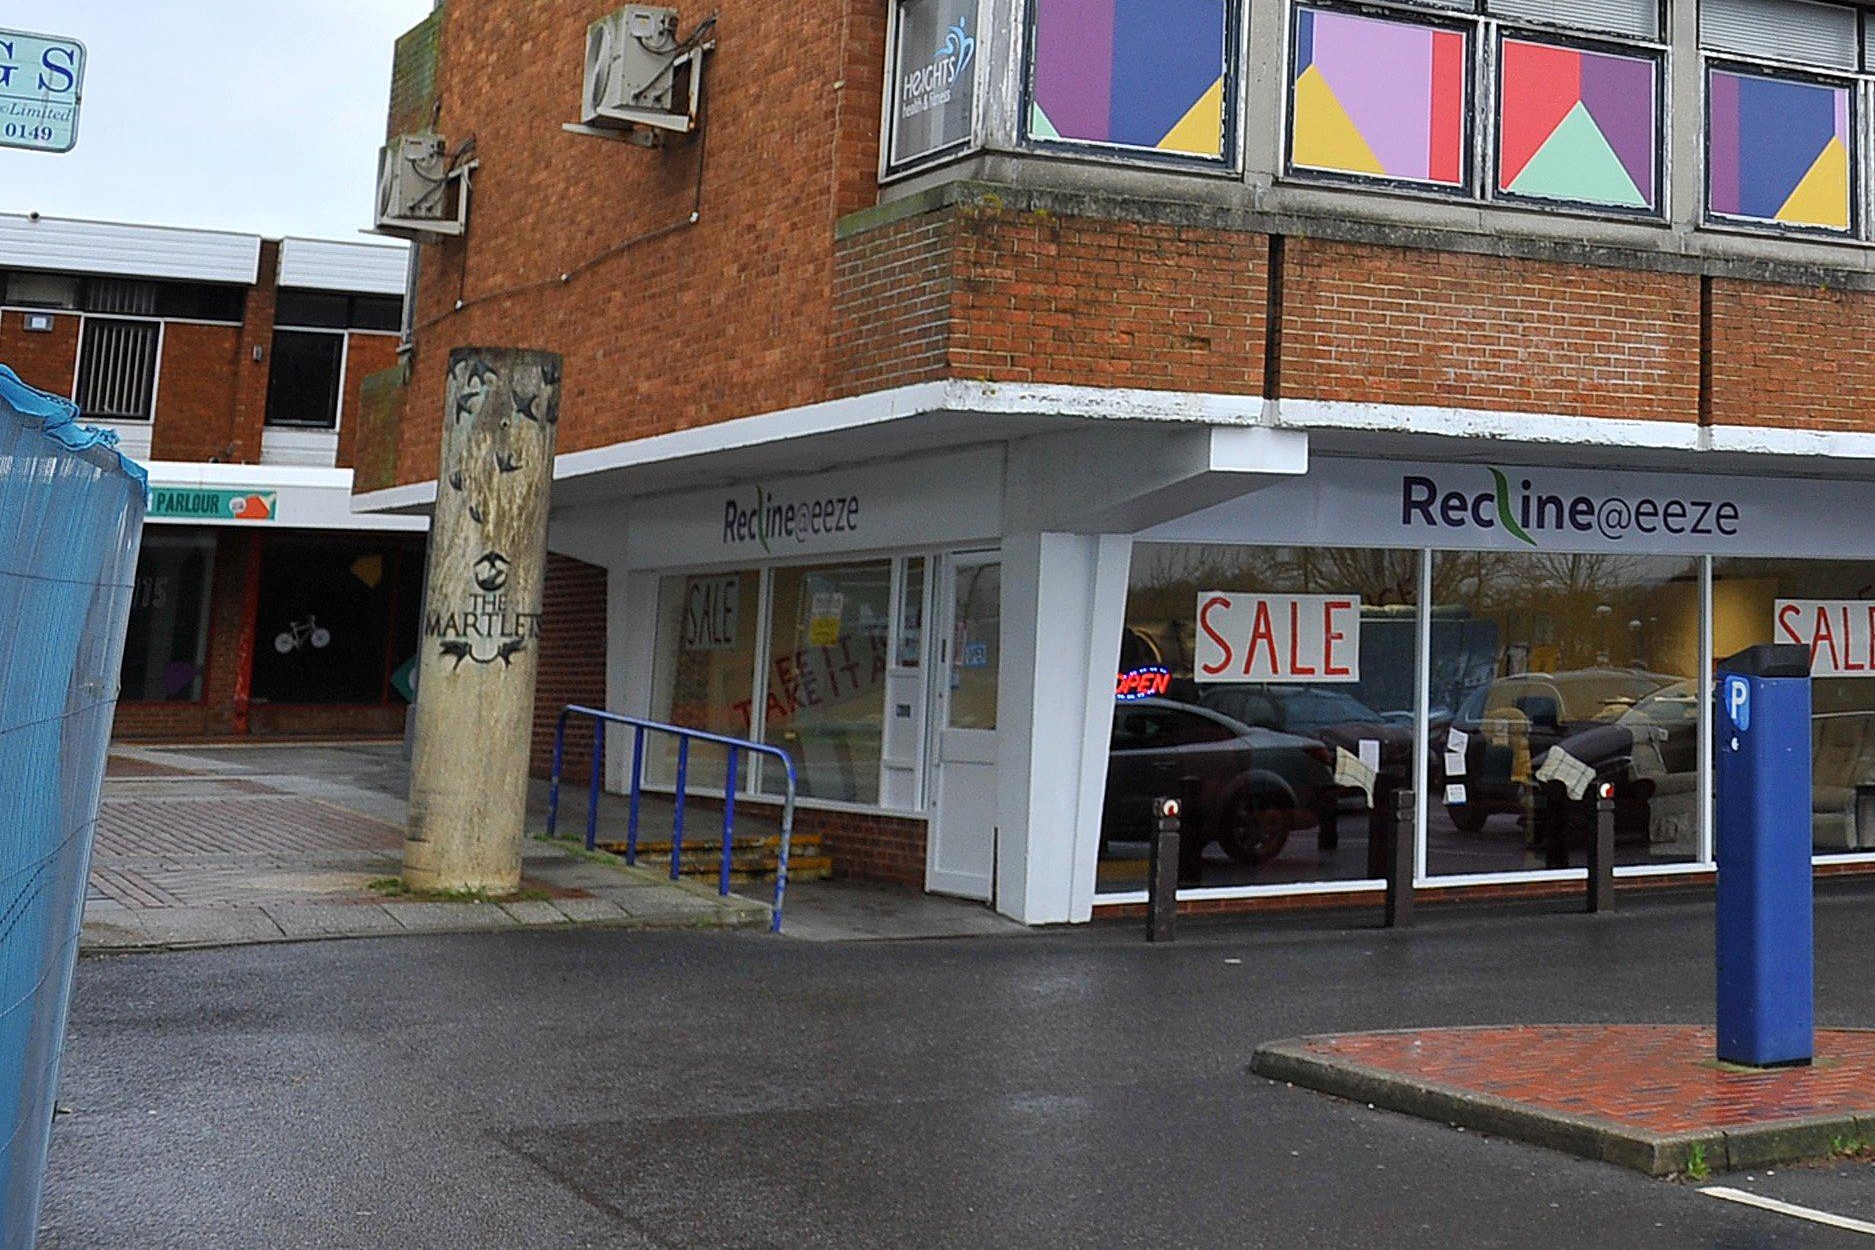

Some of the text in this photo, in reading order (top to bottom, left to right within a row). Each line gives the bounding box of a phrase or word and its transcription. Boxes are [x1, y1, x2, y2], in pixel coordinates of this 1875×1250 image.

[9, 102, 72, 122] Limited
[5, 122, 53, 141] 0149
[156, 491, 219, 514] PARLOUR
[468, 593, 507, 613] THE
[687, 580, 736, 646] SALE
[1200, 596, 1352, 675] SALE
[1731, 680, 1747, 720] P
